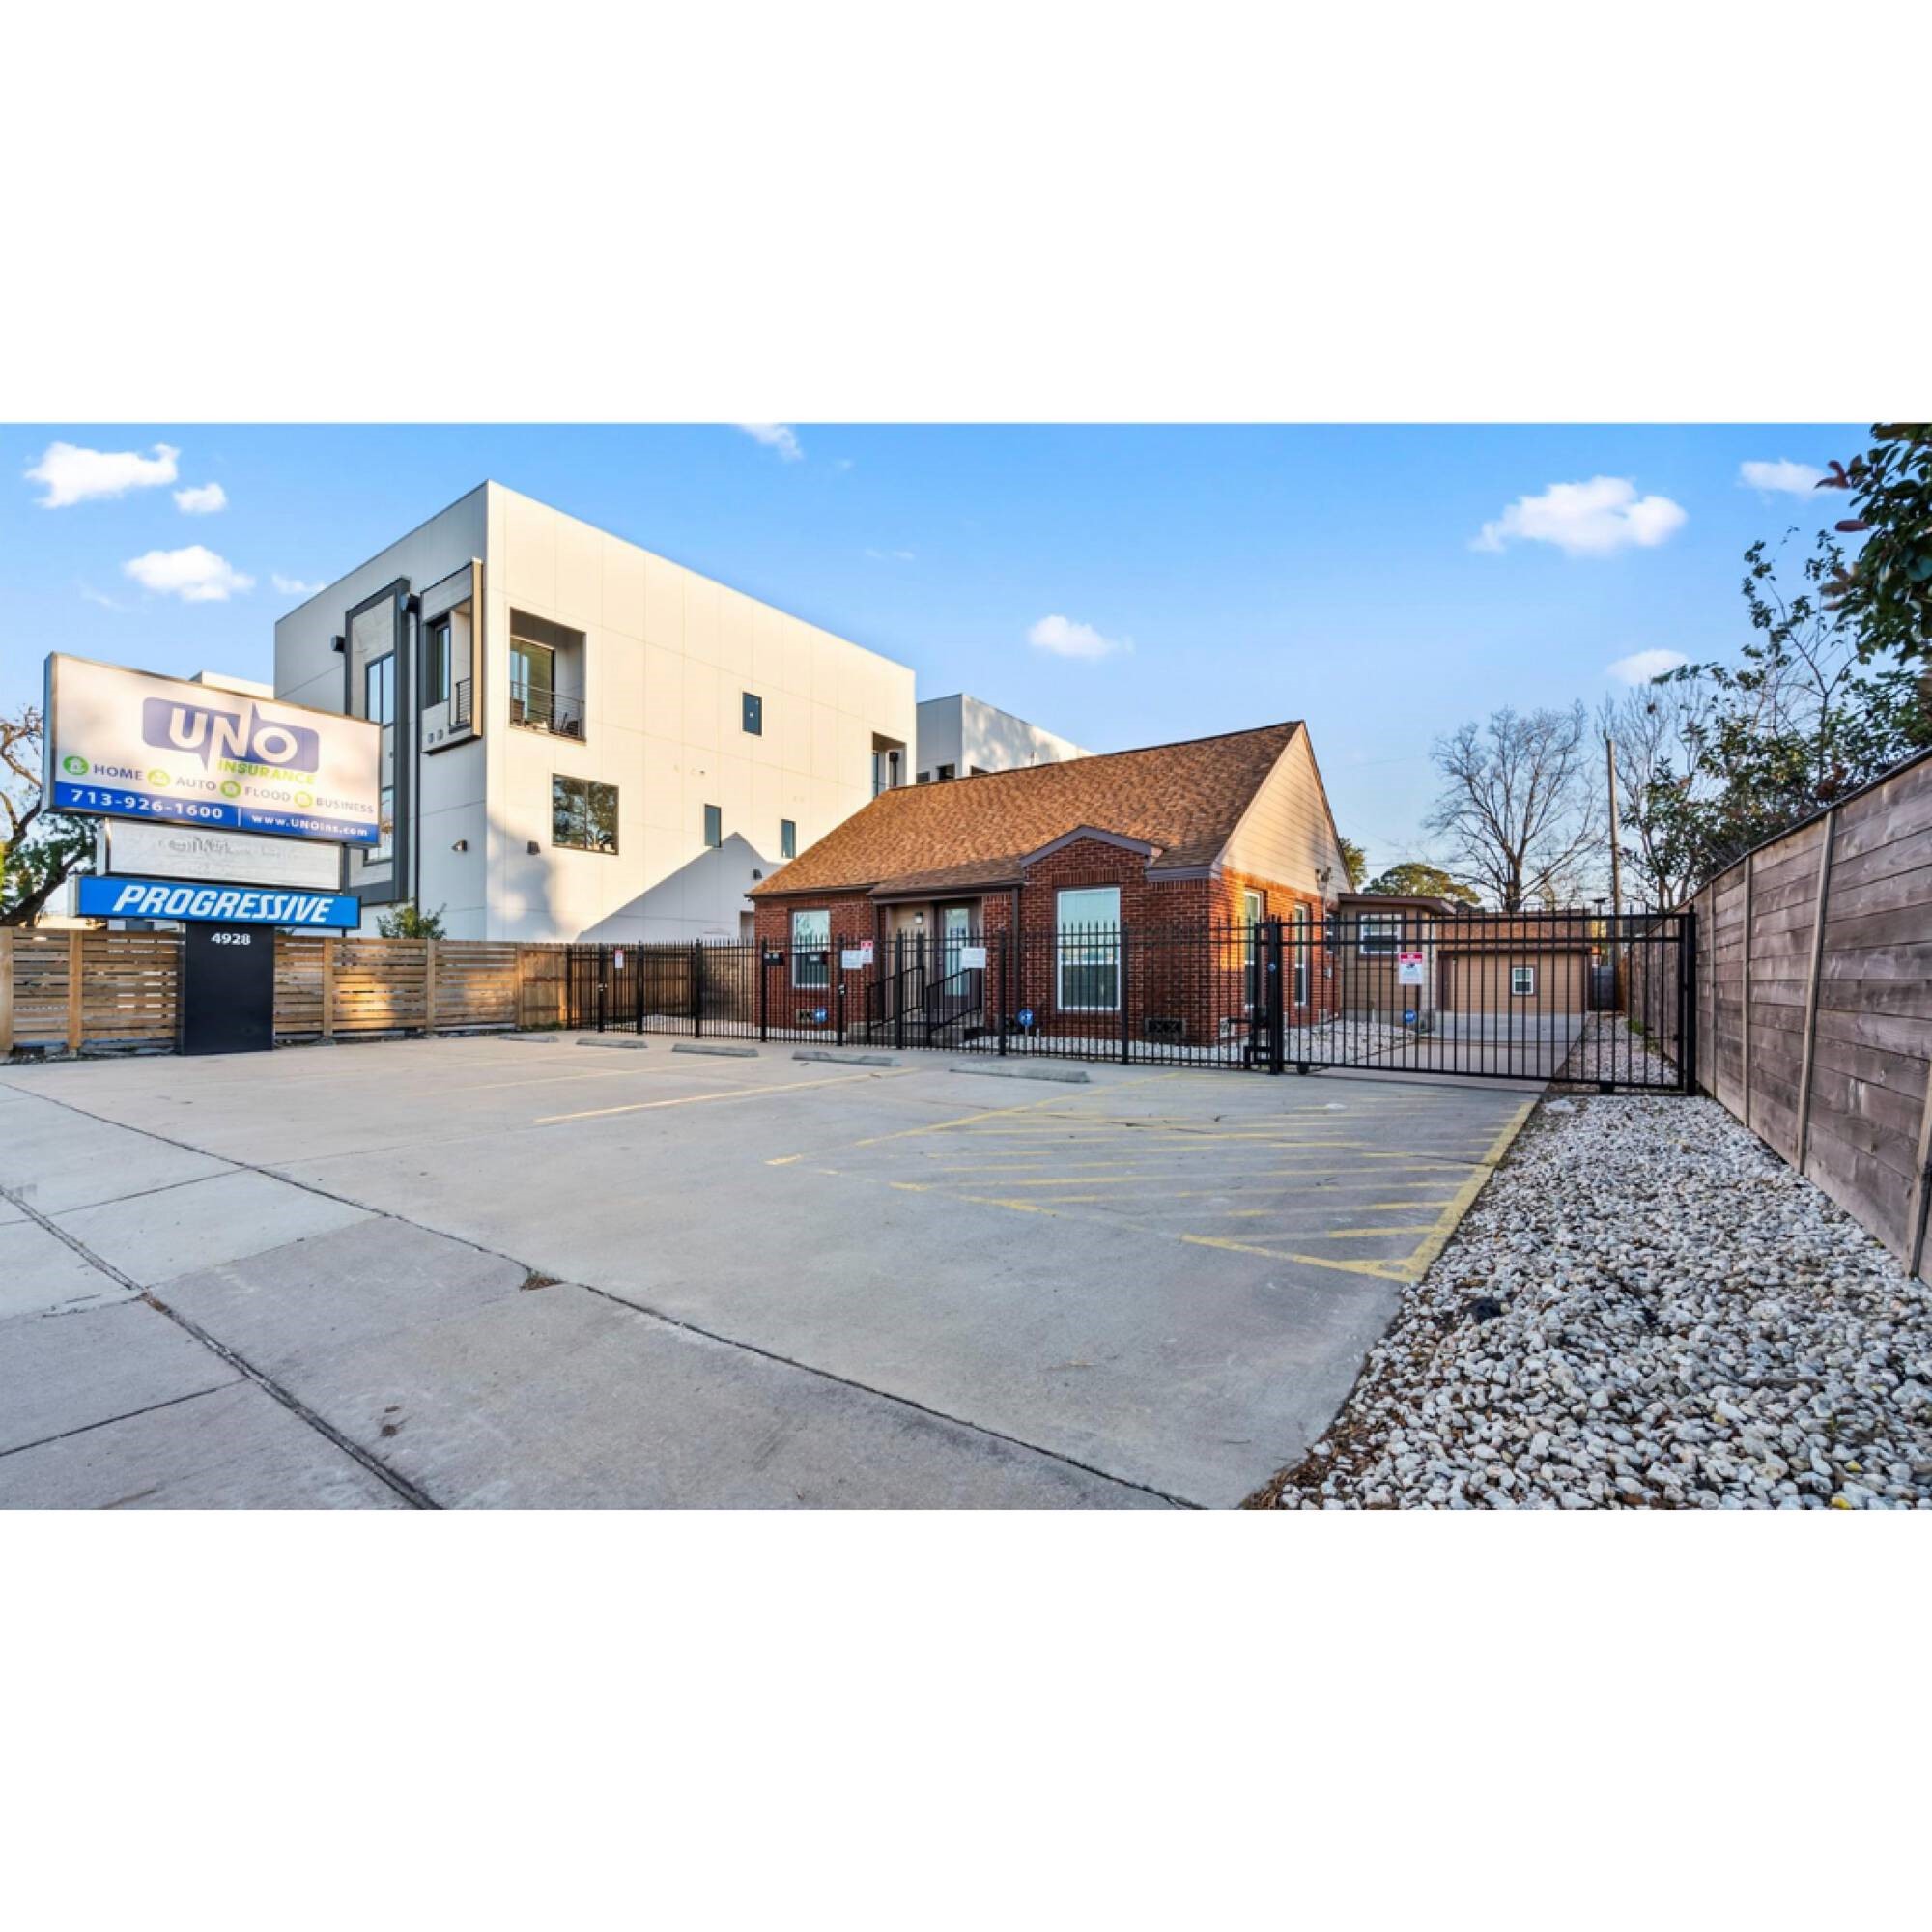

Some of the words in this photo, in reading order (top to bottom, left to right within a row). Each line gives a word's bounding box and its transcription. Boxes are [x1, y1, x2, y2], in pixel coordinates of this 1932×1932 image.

[169, 705, 298, 764] UNO
[94, 764, 144, 781] HOME
[175, 776, 217, 791] AUTO
[244, 786, 292, 802] FLOOD
[316, 797, 375, 813] BUSINESS
[216, 758, 317, 784] INSURANCE
[71, 788, 223, 820] 713-926-1600
[112, 884, 334, 923] PROGRESSIVE
